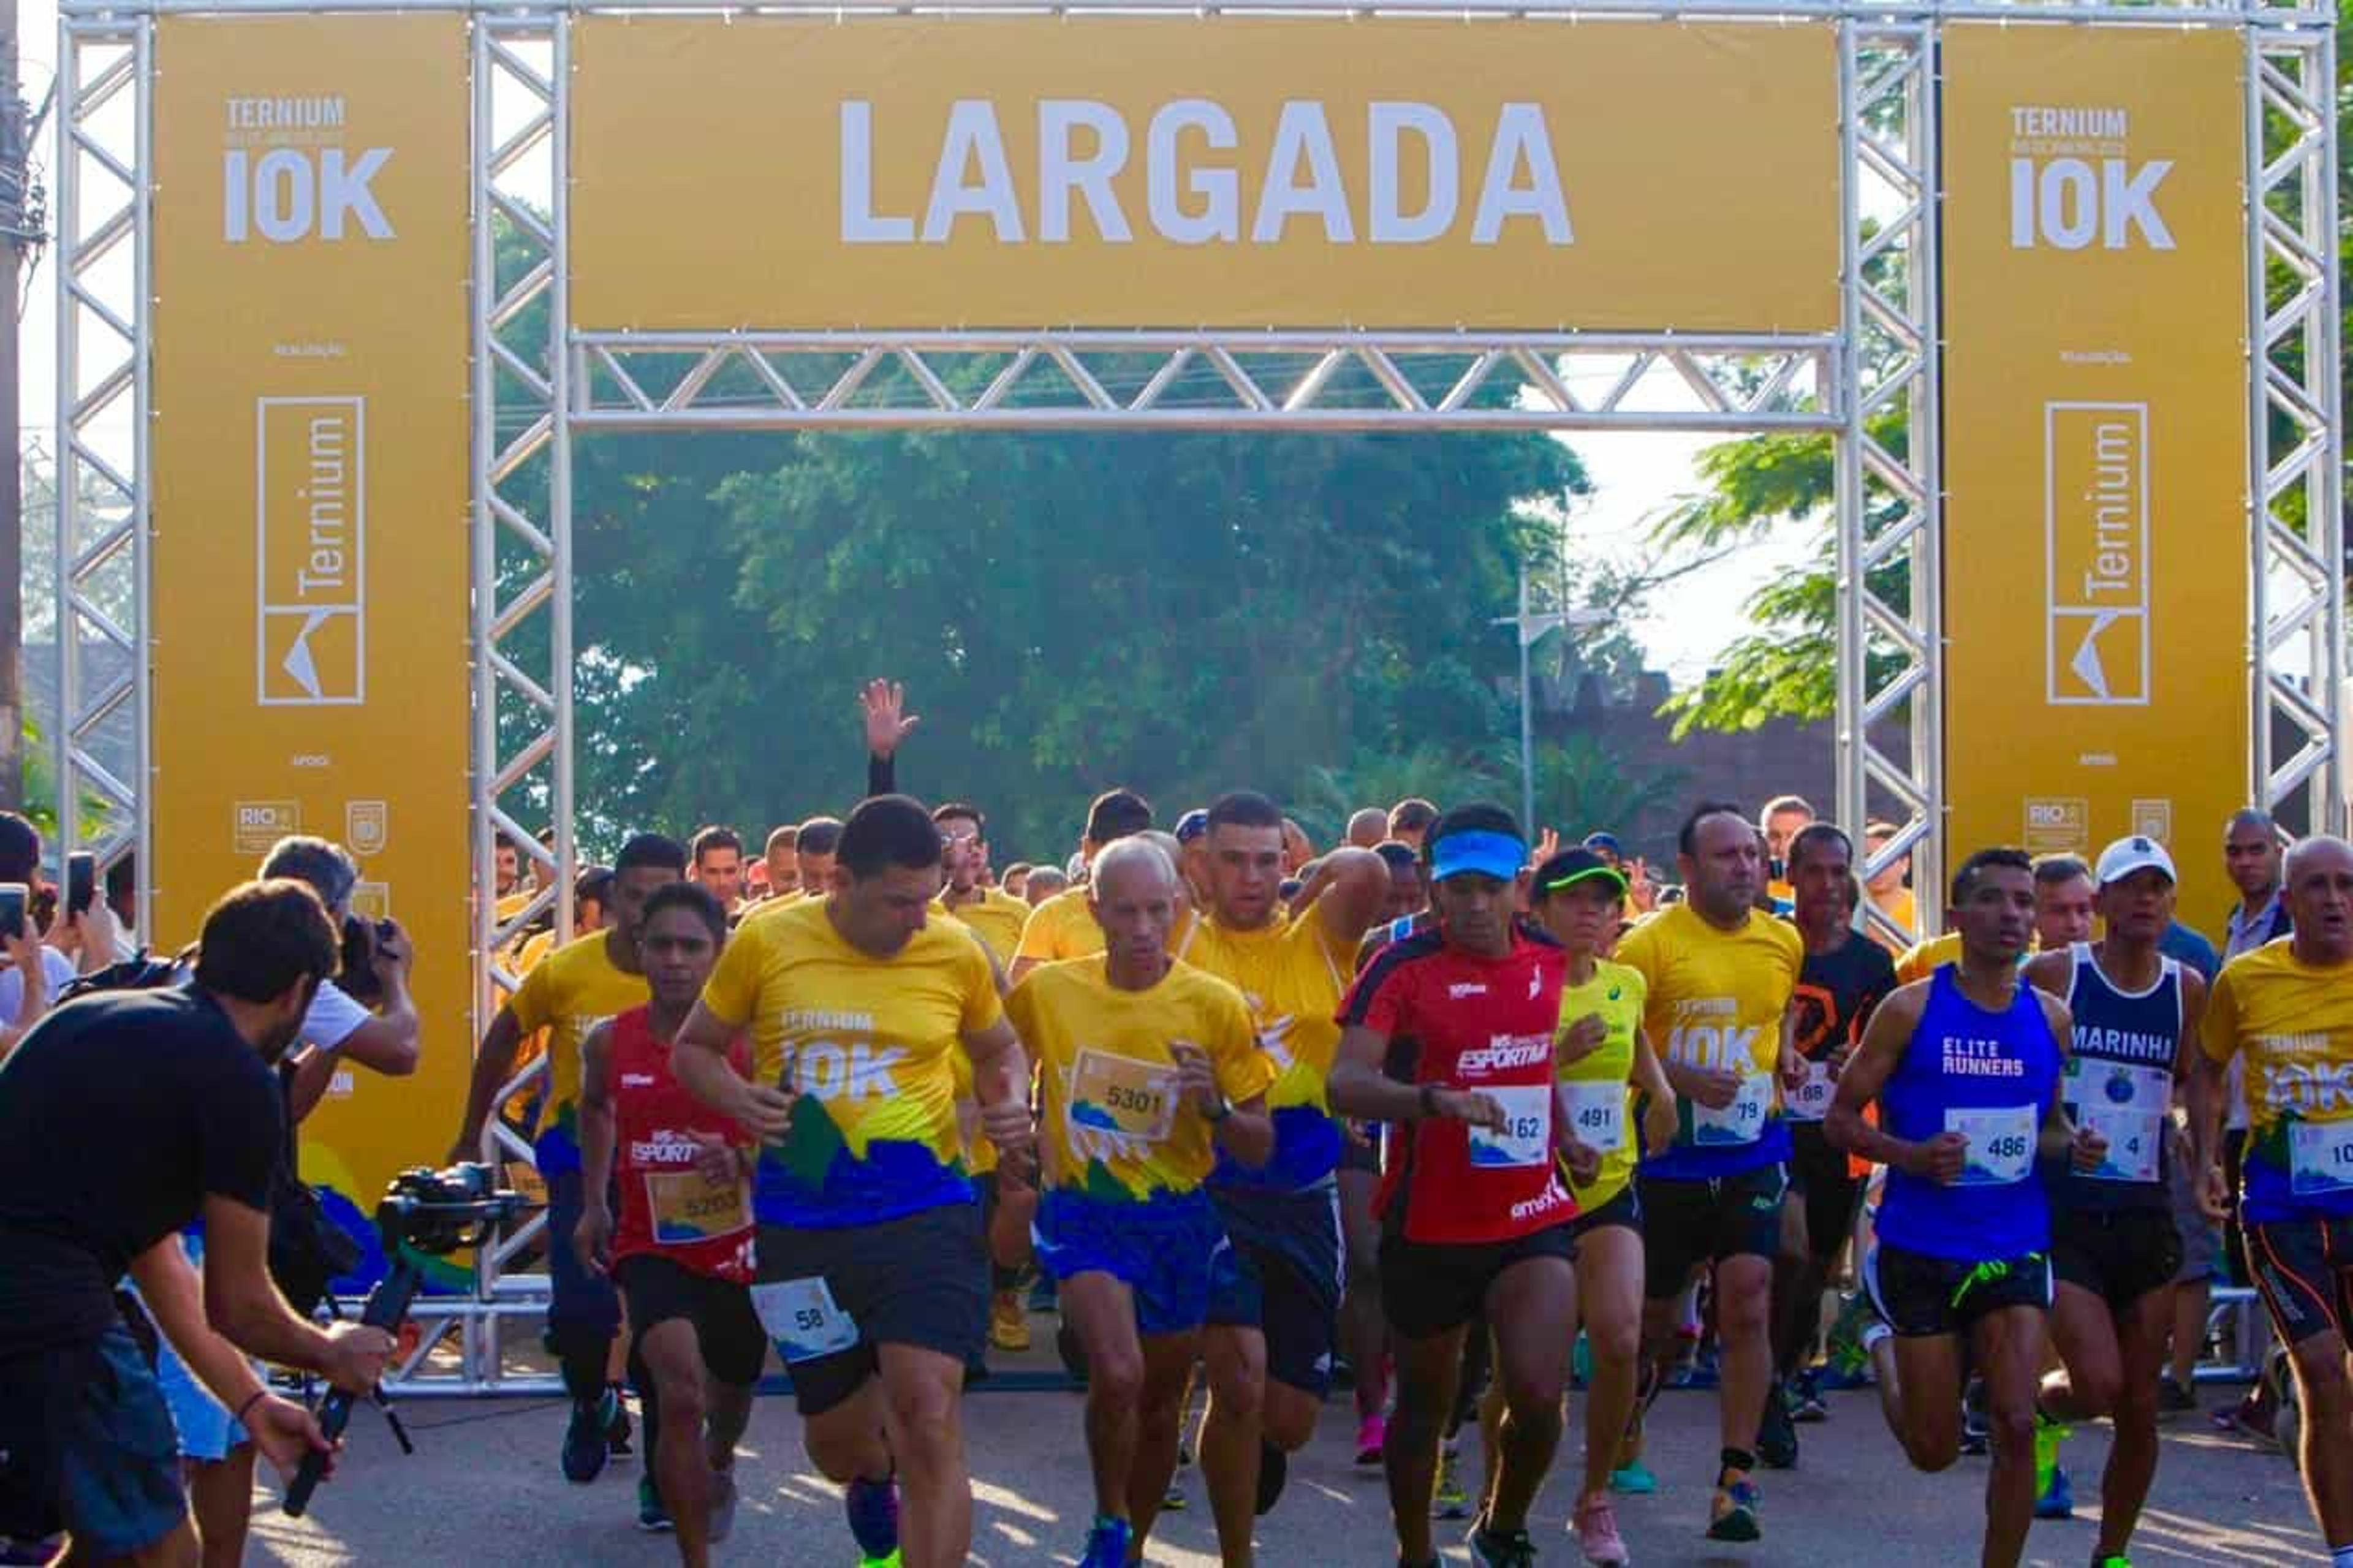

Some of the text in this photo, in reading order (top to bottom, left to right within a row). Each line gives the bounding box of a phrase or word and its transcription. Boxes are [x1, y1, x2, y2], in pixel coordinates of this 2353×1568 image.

[227, 98, 344, 127] TERNIUM
[2011, 107, 2126, 137] TERNIUM
[839, 98, 1575, 244] LARGADA
[224, 147, 397, 243] 10K
[2010, 158, 2177, 250] 10K
[297, 416, 344, 596] Ternium
[2085, 422, 2130, 599] Ternium
[240, 808, 275, 825] RIO
[1458, 1043, 1549, 1070] ESPORTIV
[1942, 1037, 2000, 1058] ELITE
[1942, 1055, 2023, 1077] RUNNERS
[1107, 1088, 1162, 1116] 5301
[1578, 1108, 1610, 1127] 491
[1988, 1137, 2026, 1157] 486
[2126, 1137, 2139, 1155] 4
[795, 1308, 824, 1331] 58
